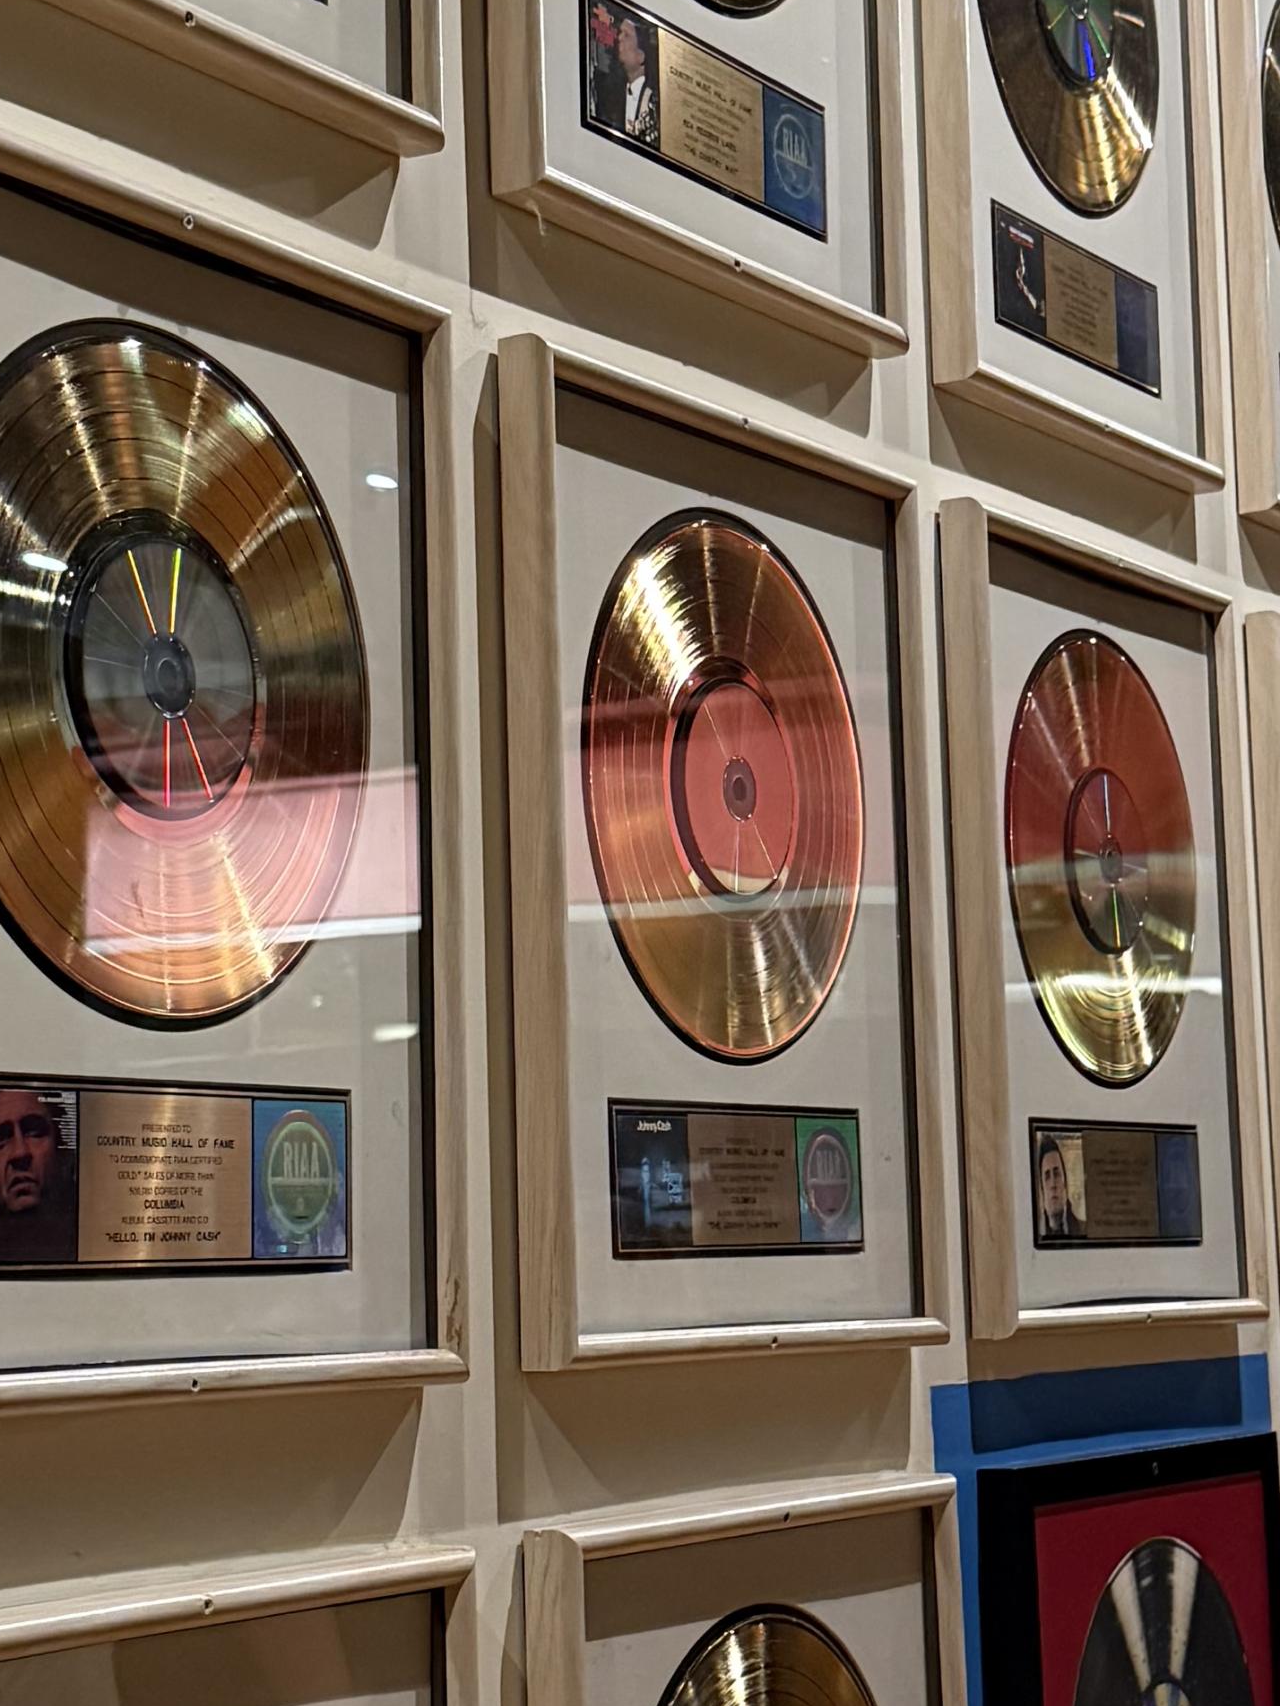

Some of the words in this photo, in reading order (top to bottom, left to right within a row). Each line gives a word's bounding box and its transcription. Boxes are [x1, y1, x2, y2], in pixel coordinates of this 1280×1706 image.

[782, 125, 808, 168] RIAA
[96, 1135, 136, 1147] COUNTRY
[141, 1136, 166, 1147] MUSIC
[171, 1137, 192, 1148] HALL
[197, 1137, 208, 1148] OF
[213, 1138, 235, 1149] FAME
[283, 1142, 321, 1180] RIAA
[144, 1199, 184, 1209] COLUMBIA
[159, 1232, 191, 1242] JOHNNY
